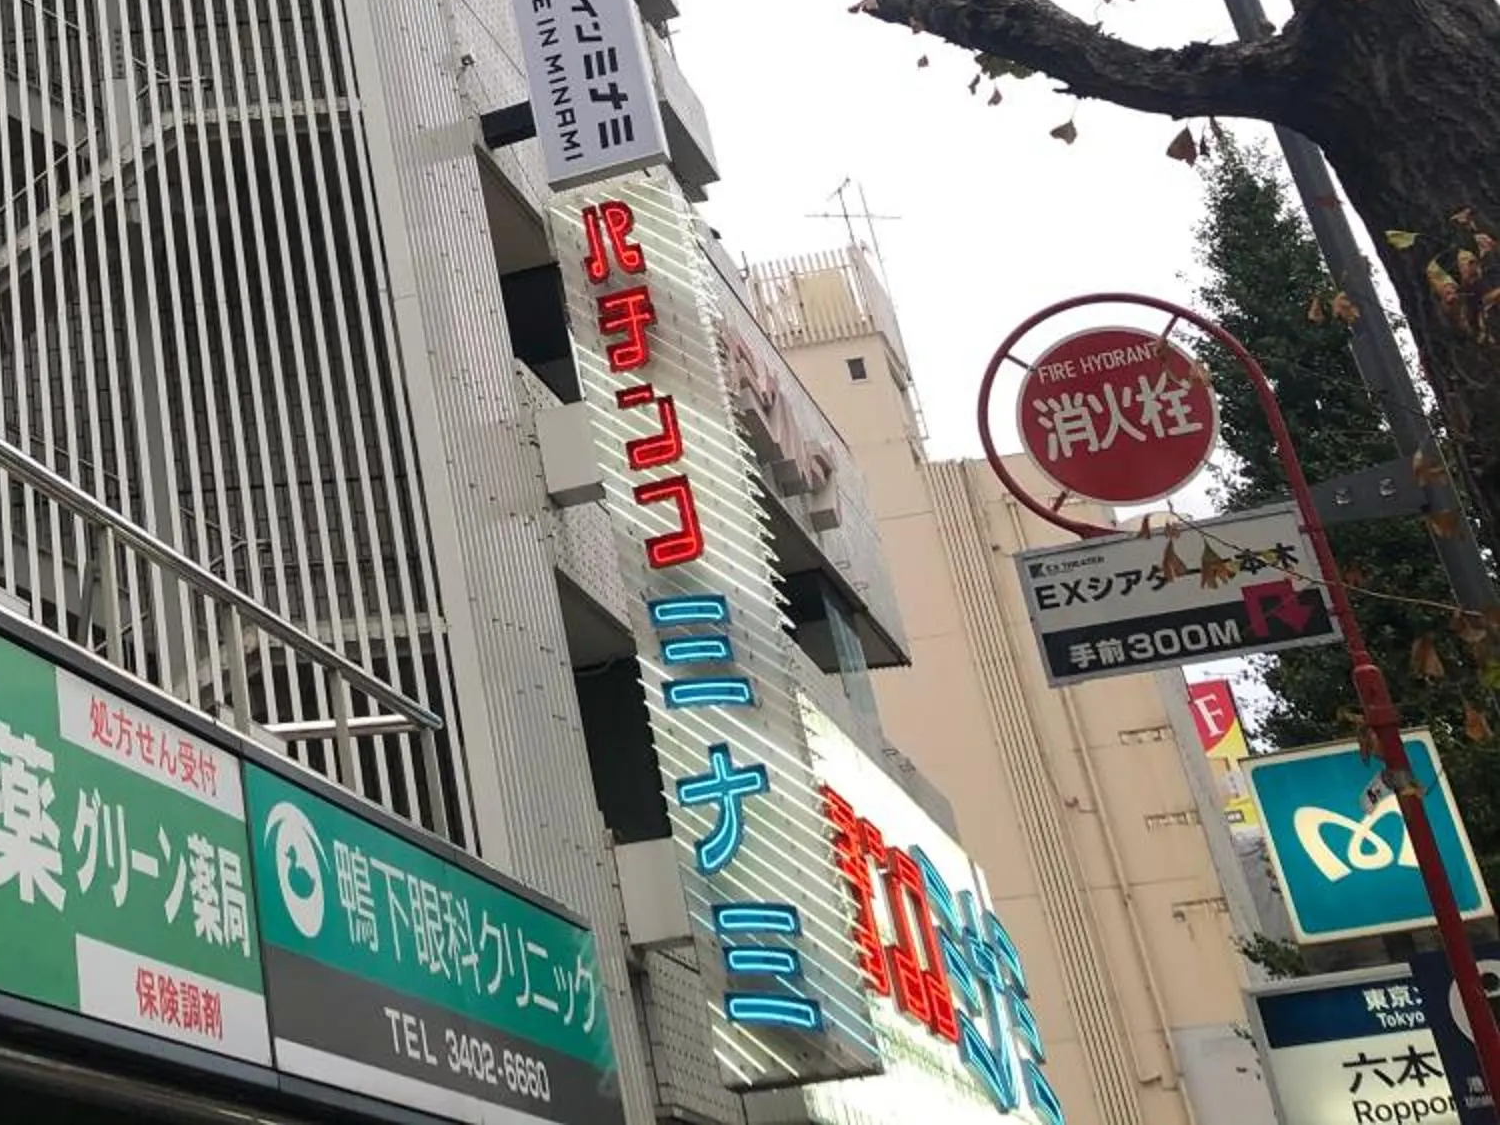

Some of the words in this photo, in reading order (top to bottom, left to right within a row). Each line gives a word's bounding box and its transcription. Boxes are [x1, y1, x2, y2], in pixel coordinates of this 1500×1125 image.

[537, 19, 559, 48] IN
[545, 53, 584, 163] MINAMI
[1037, 360, 1077, 384] FIRE
[1080, 341, 1160, 375] HYDRANT
[1032, 372, 1203, 462] 消火栓
[89, 695, 218, 798] 処方せん受付
[1194, 692, 1225, 738] F
[72, 787, 251, 958] グリーン薬局
[333, 839, 596, 1034] 鴨下眼科クリニック
[135, 964, 224, 1041] 保険調剤
[1376, 1011, 1426, 1029] Tokyo
[384, 1006, 438, 1066] TEL
[445, 1028, 551, 1103] 3402-6660
